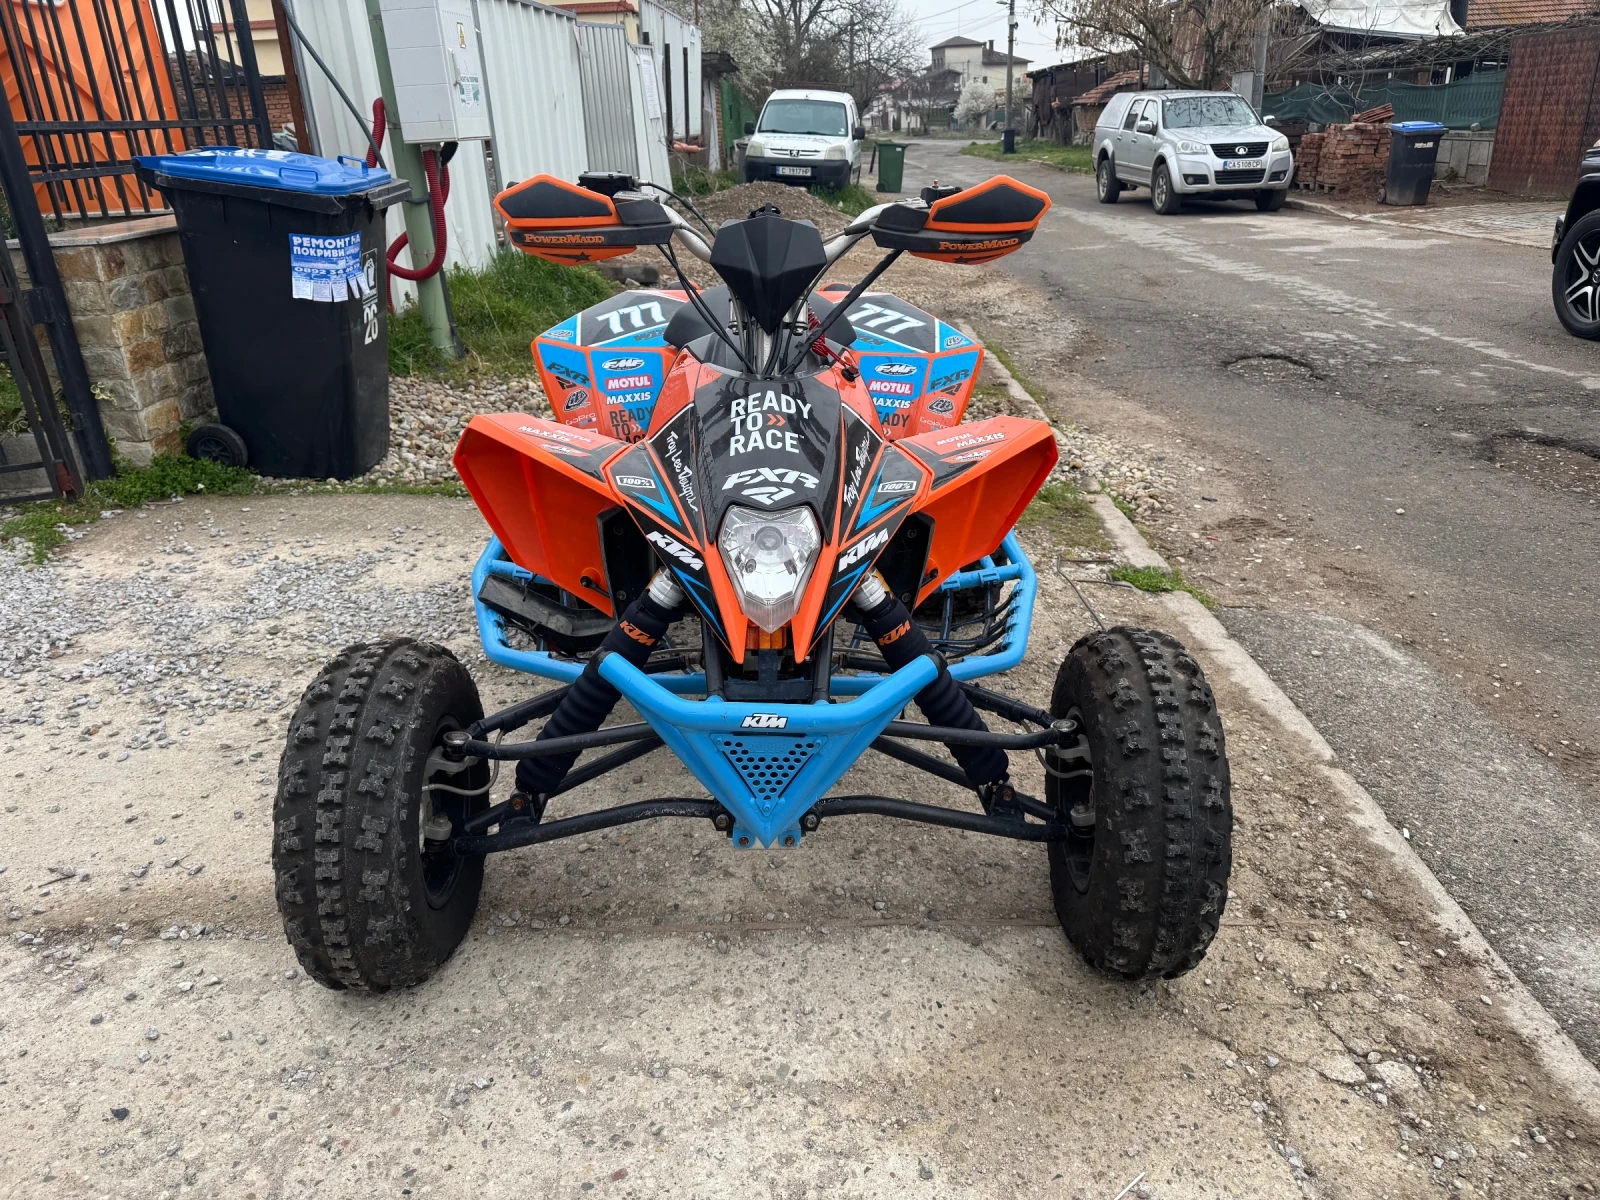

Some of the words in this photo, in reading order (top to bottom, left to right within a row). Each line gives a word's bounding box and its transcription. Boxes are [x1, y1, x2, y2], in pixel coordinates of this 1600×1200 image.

[292, 236, 350, 249] РЕМОНТ
[293, 246, 346, 258] ПОКРИВИ
[294, 266, 327, 275] 0892
[595, 301, 666, 334] 777
[847, 302, 927, 335] 777
[547, 362, 590, 385] FXR
[607, 376, 651, 390] MOTUL
[930, 369, 970, 391] FXR
[606, 391, 651, 405] MAXXIS
[869, 381, 911, 394] MOTUL
[730, 390, 812, 419] READY
[612, 422, 631, 437] TO
[730, 412, 763, 436] TO
[729, 429, 800, 457] RACE
[936, 432, 973, 446] MOTUL
[956, 432, 1005, 448] MAXXIS
[665, 431, 679, 458] Troy
[672, 450, 683, 473] Lee
[623, 477, 650, 487] 100%
[721, 467, 820, 491] FXR
[851, 465, 862, 488] Lee
[883, 482, 911, 491] 100%
[843, 482, 860, 507] Troy
[646, 531, 704, 571] KTM
[838, 528, 889, 572] KTM
[620, 620, 656, 646] KTM
[879, 620, 911, 646] KTM
[742, 713, 788, 729] KTM
